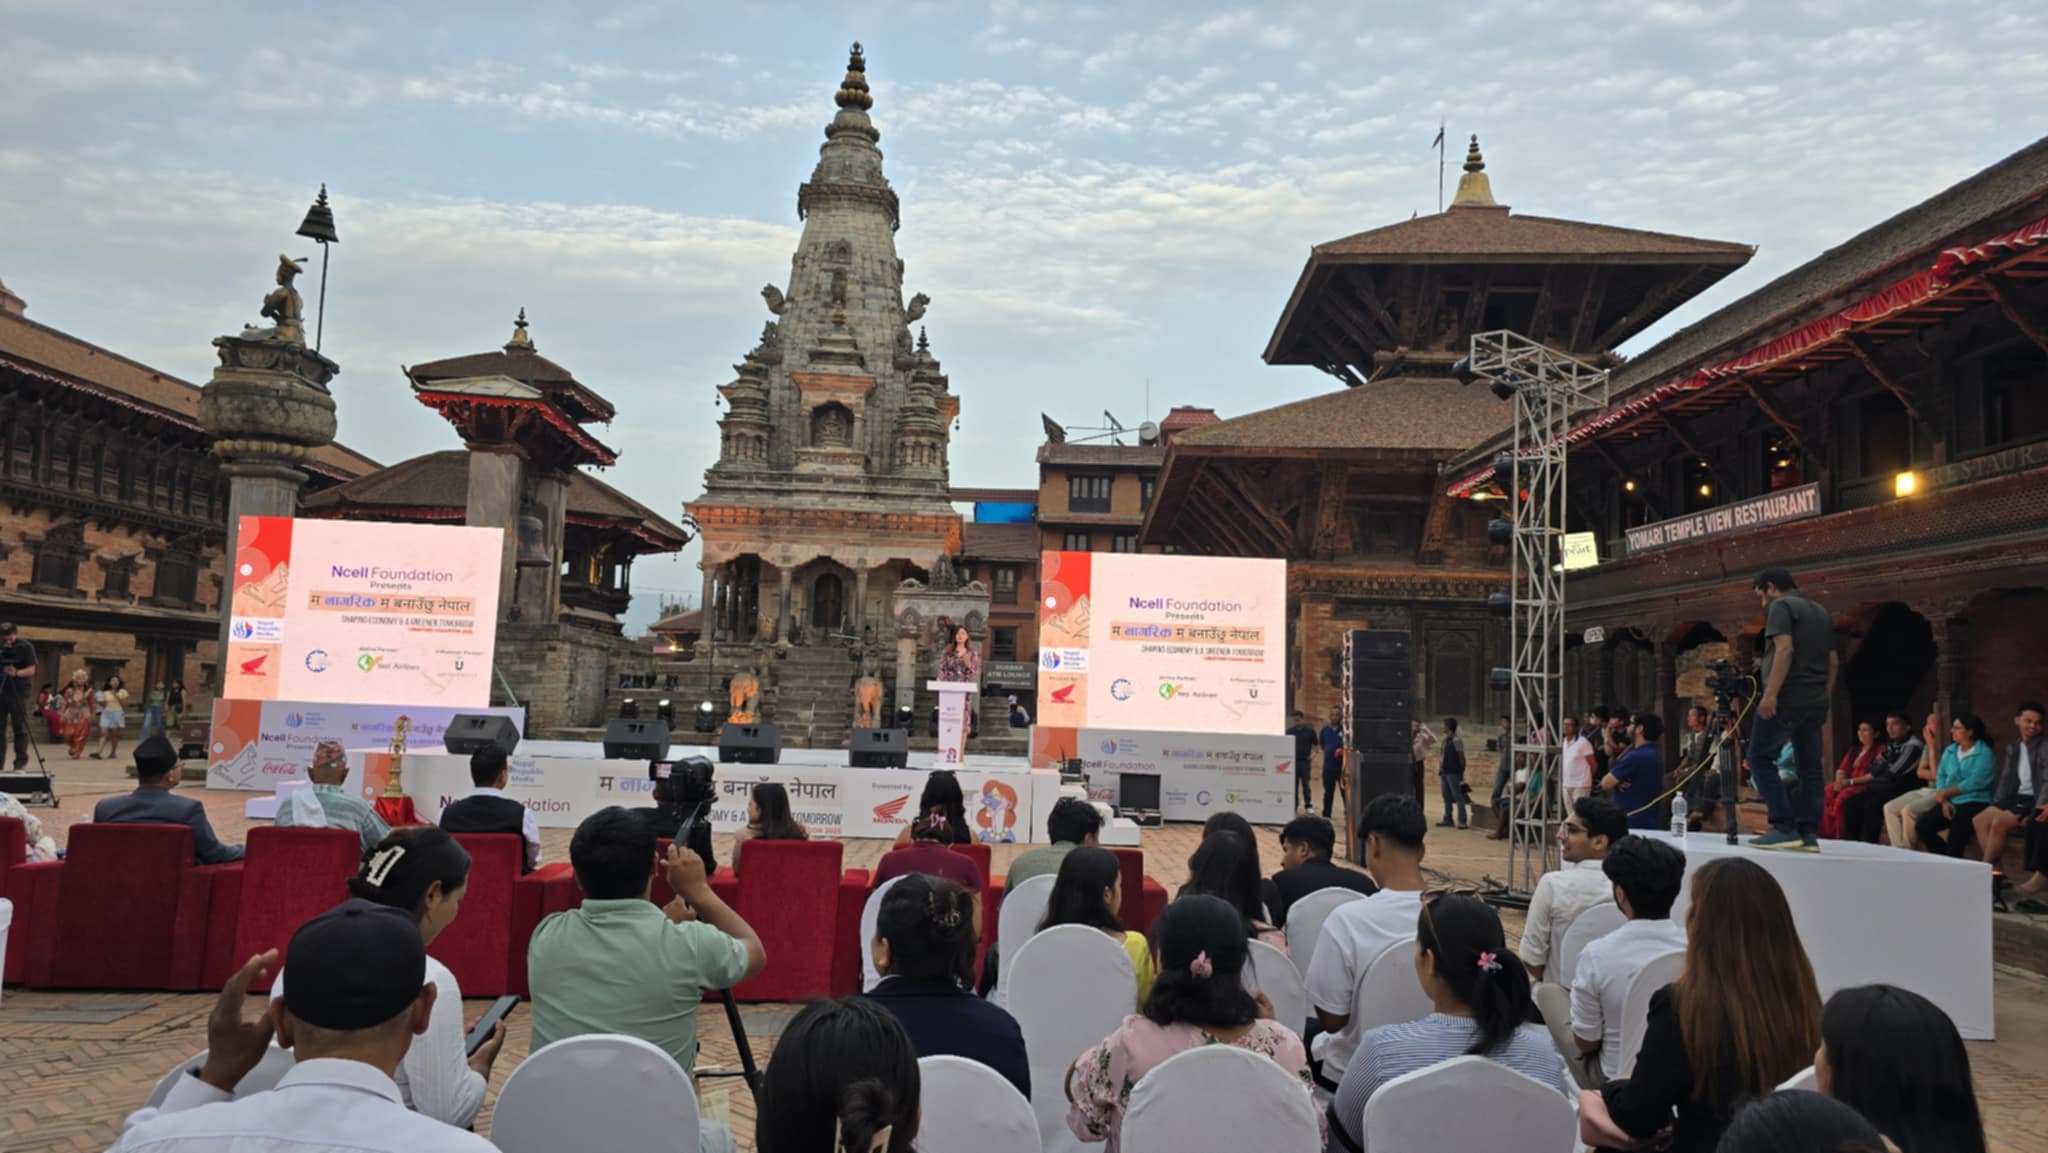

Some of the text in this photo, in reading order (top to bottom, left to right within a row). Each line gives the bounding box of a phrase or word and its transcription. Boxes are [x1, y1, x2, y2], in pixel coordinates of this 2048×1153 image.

[1628, 489, 1816, 551] YOMARI TEMPLE VIEW RESTAURANT
[332, 565, 453, 582] Ncell Foundation
[370, 581, 412, 590] Presents
[311, 595, 320, 606] म
[380, 598, 389, 608] म
[438, 598, 470, 612] नेपाल
[1129, 597, 1241, 612] Ncell Foundation
[1165, 611, 1205, 621] Presents
[1112, 625, 1121, 636] म
[1176, 627, 1185, 638] म
[1230, 626, 1260, 641] नेपाल
[261, 732, 286, 742] Ncell
[1104, 760, 1156, 769] Foundation
[600, 776, 613, 792] म
[790, 776, 837, 799] नेपाल
[522, 798, 570, 812] dation
[872, 817, 909, 825] HONDA
